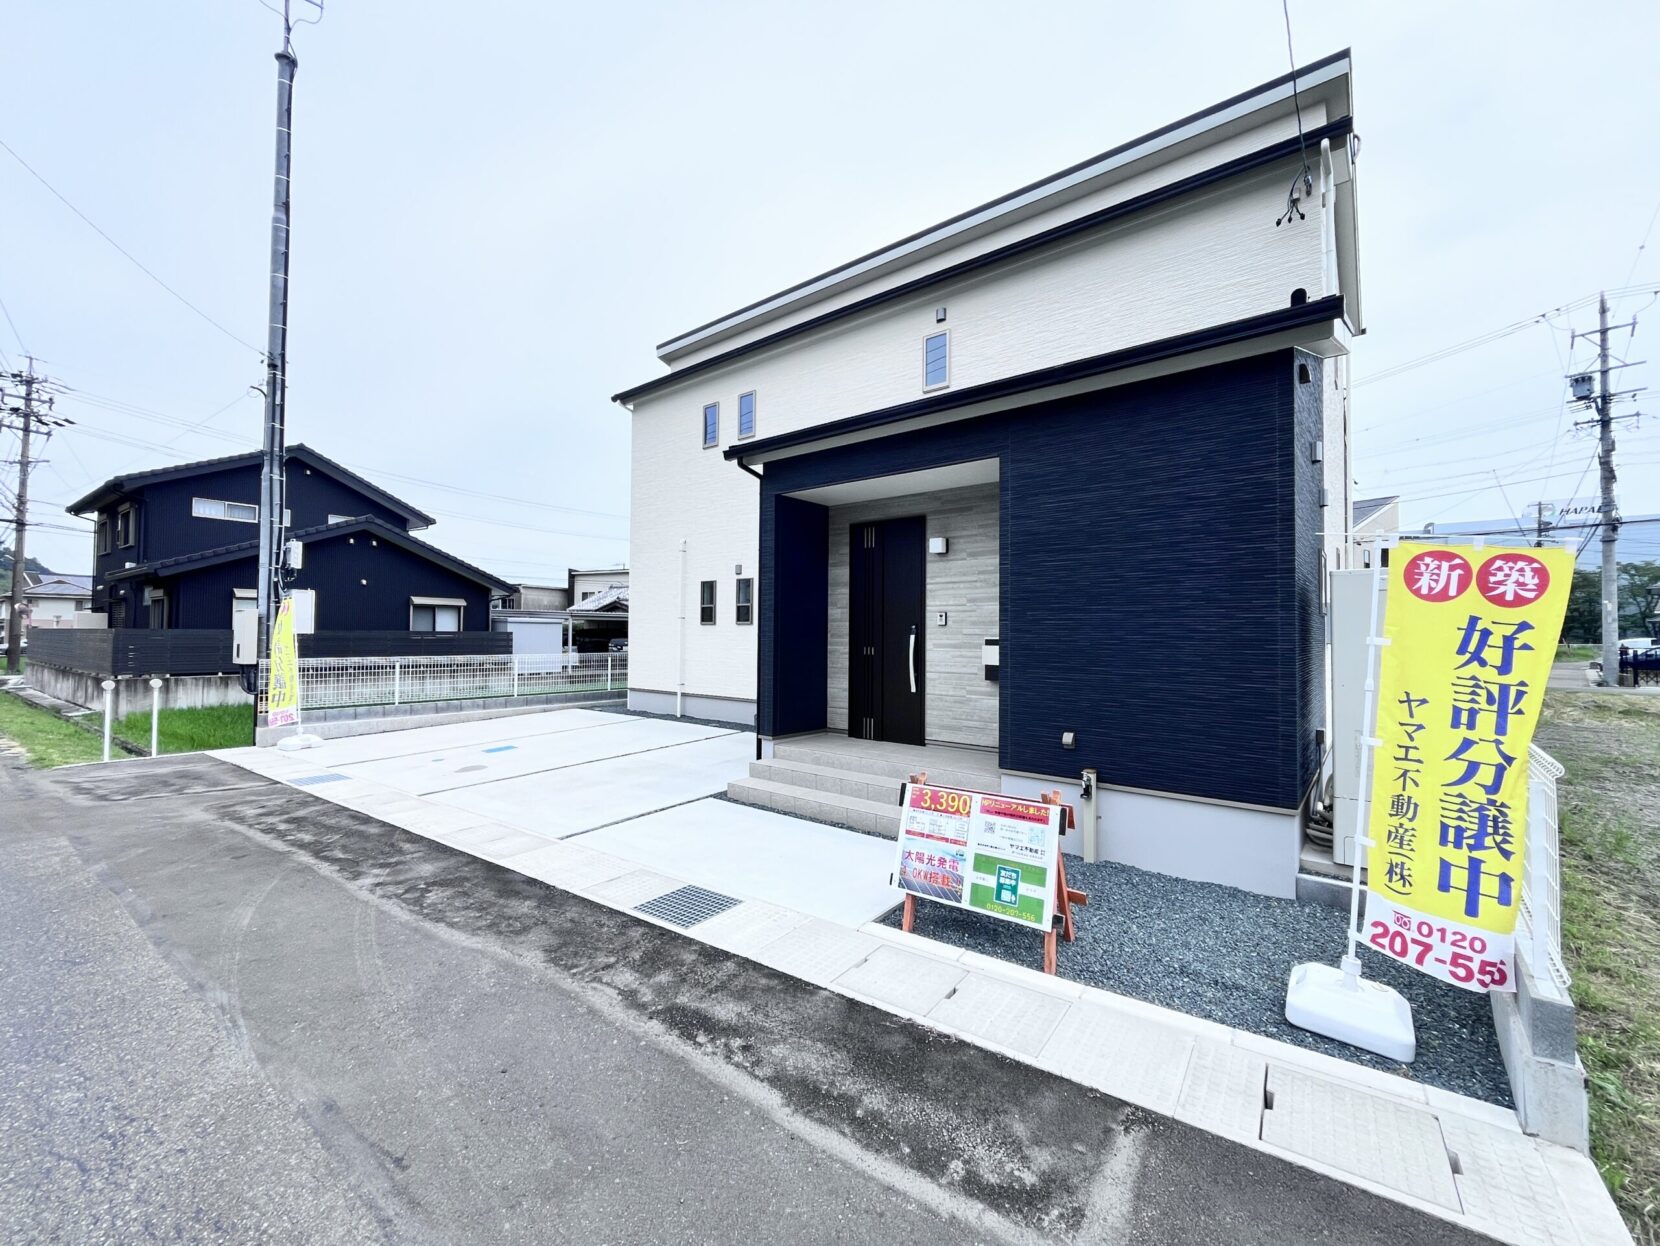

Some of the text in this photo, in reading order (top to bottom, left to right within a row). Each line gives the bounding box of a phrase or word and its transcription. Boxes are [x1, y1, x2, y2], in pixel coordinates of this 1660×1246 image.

[1411, 555, 1541, 601] 新築
[1437, 614, 1536, 918] 好評分譲中
[920, 789, 970, 814] 3,390
[1416, 921, 1487, 955] 0120
